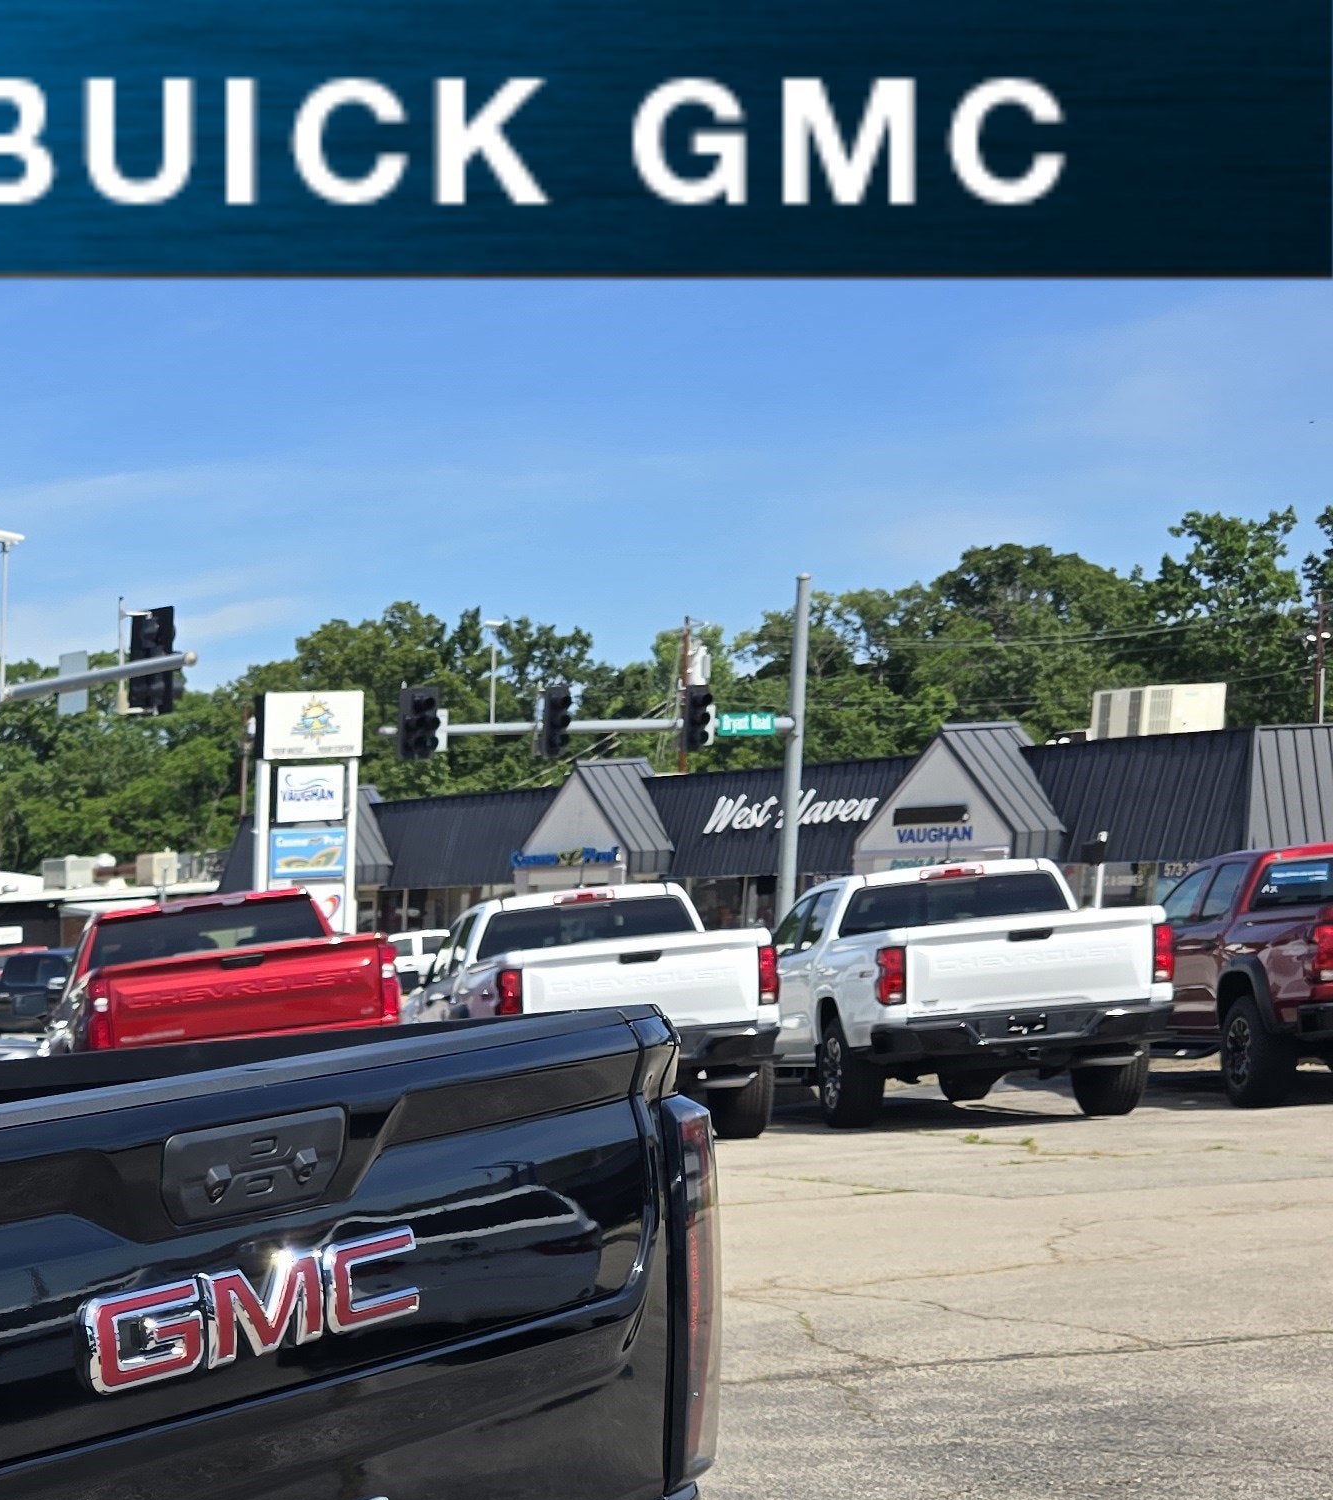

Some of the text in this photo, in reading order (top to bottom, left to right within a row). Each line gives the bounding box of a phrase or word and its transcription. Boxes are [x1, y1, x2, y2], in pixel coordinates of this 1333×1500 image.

[702, 794, 778, 834] West
[896, 825, 973, 843] VAUGHAN
[127, 967, 362, 1010] CHEVROLET
[83, 1224, 420, 1395] GMC
